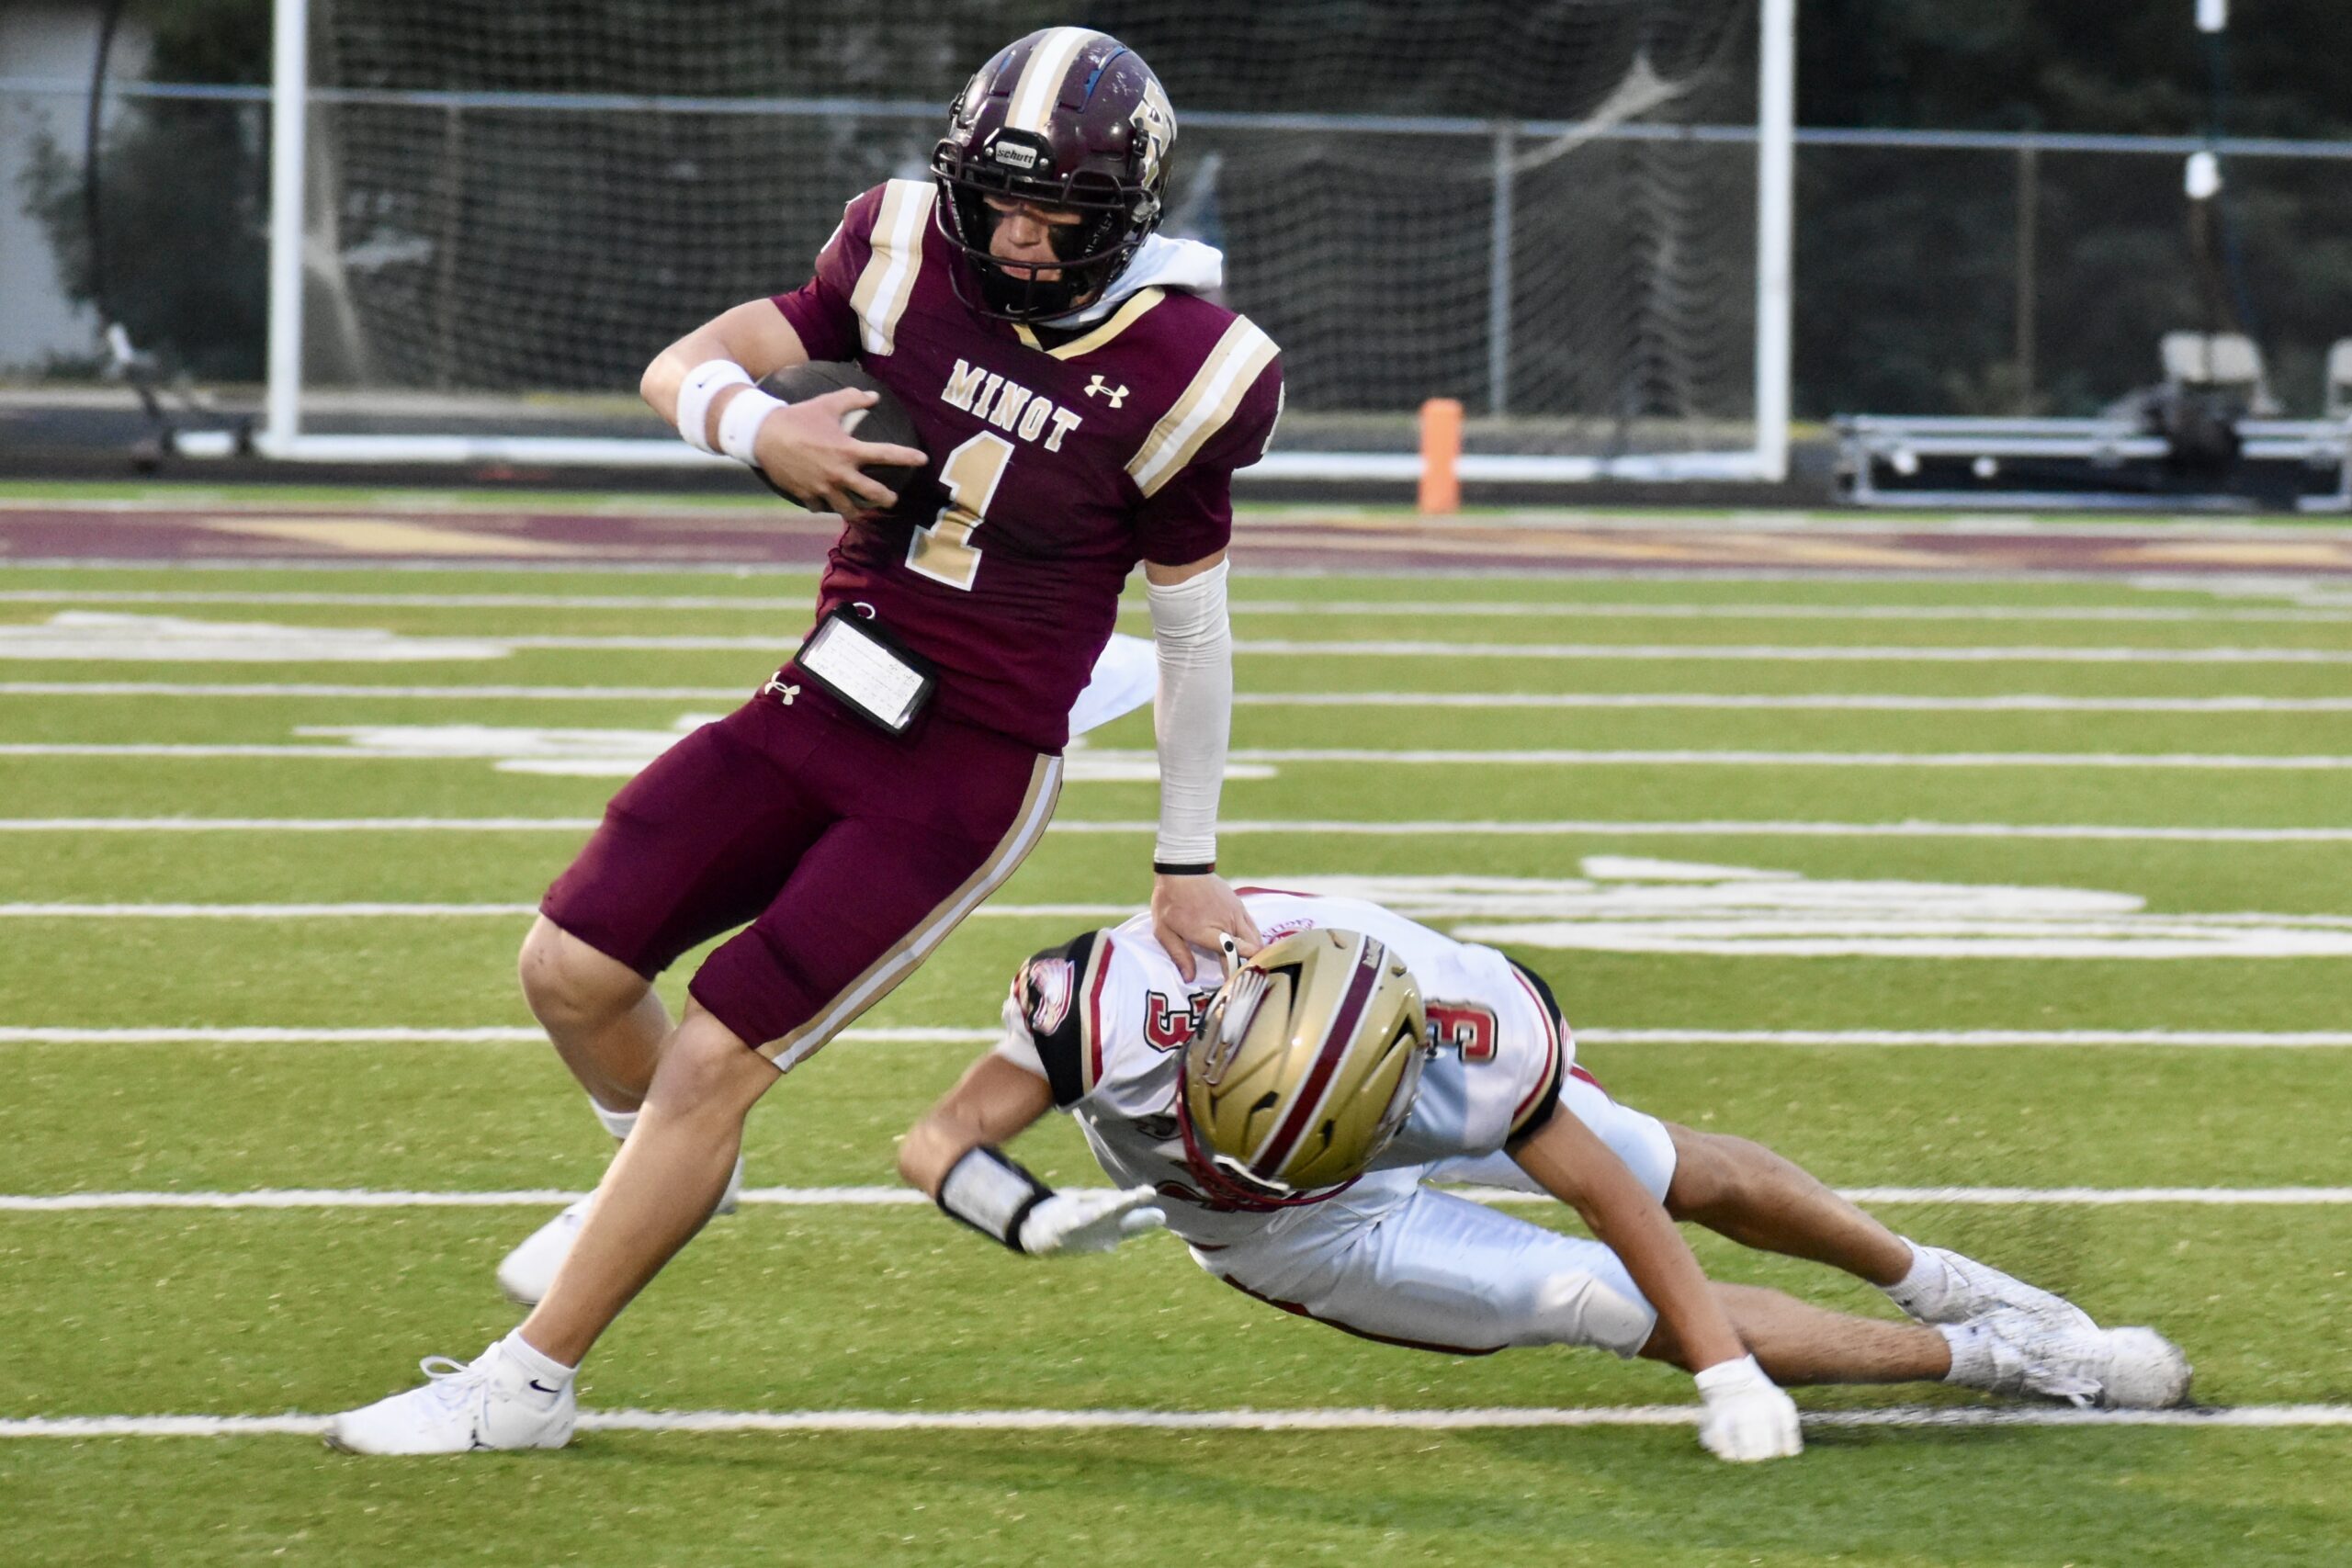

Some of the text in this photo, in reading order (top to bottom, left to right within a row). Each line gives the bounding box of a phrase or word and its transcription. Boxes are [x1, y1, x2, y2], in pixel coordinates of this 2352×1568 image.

[998, 149, 1034, 164] schutt
[941, 358, 1083, 453] MINOT
[904, 430, 1015, 592] 1
[1144, 989, 1215, 1054] 3
[1424, 998, 1498, 1064] 3
